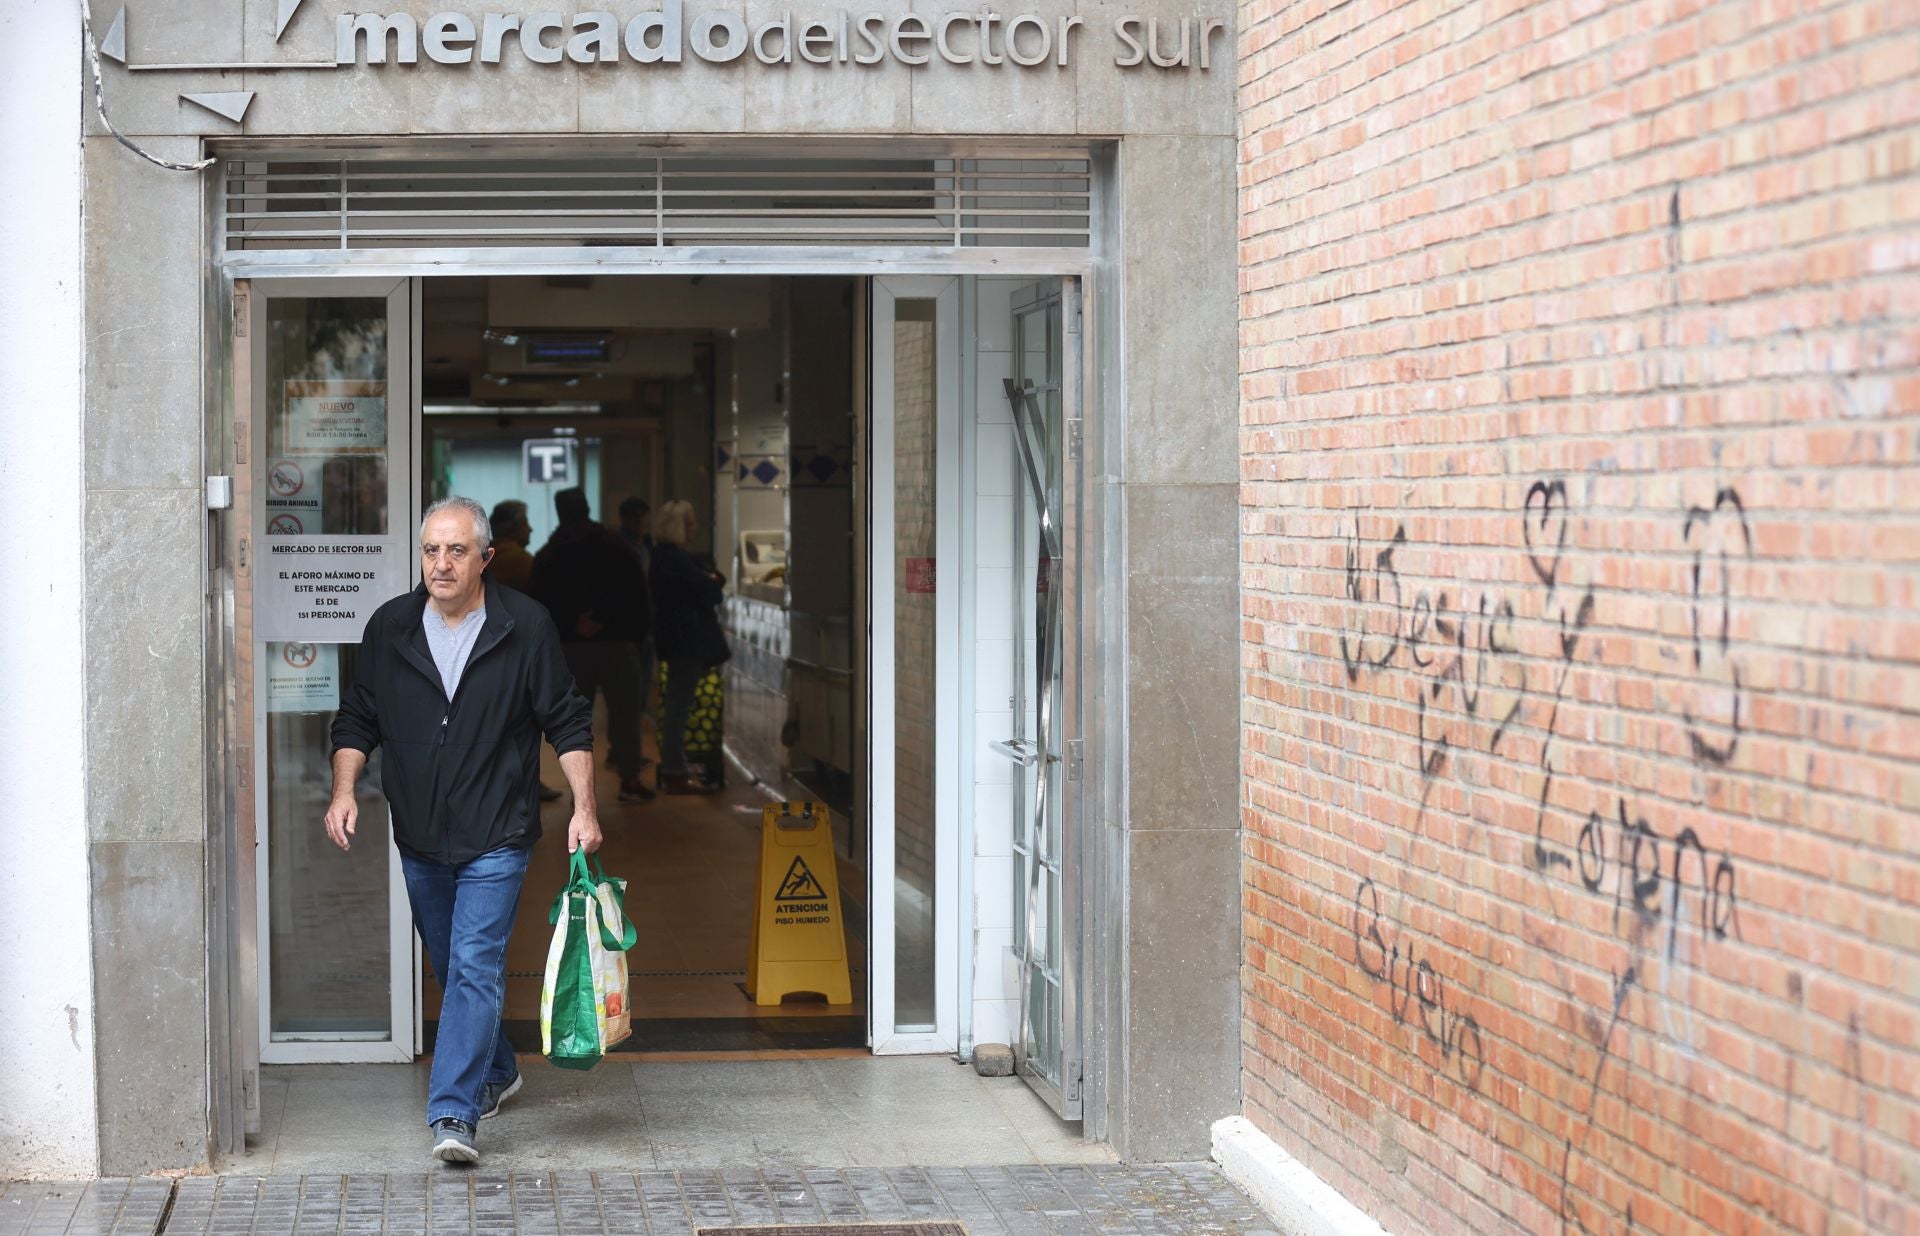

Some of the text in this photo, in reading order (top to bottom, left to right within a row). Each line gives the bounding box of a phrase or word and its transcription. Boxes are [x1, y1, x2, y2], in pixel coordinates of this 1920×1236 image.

[1115, 15, 1224, 69] sur
[319, 402, 355, 411] NUEVO
[288, 499, 319, 507] ANIMALES
[272, 545, 382, 553] MERCADO DE SECTOR SUR
[279, 570, 375, 580] EL AFORO MÁXIMO DE
[294, 585, 360, 593] ESTE MERCADO
[315, 598, 339, 606] ES DE
[311, 611, 356, 619] PERSONAS
[775, 903, 829, 914] ATENCION
[775, 916, 830, 925] PISO HUMEDO
